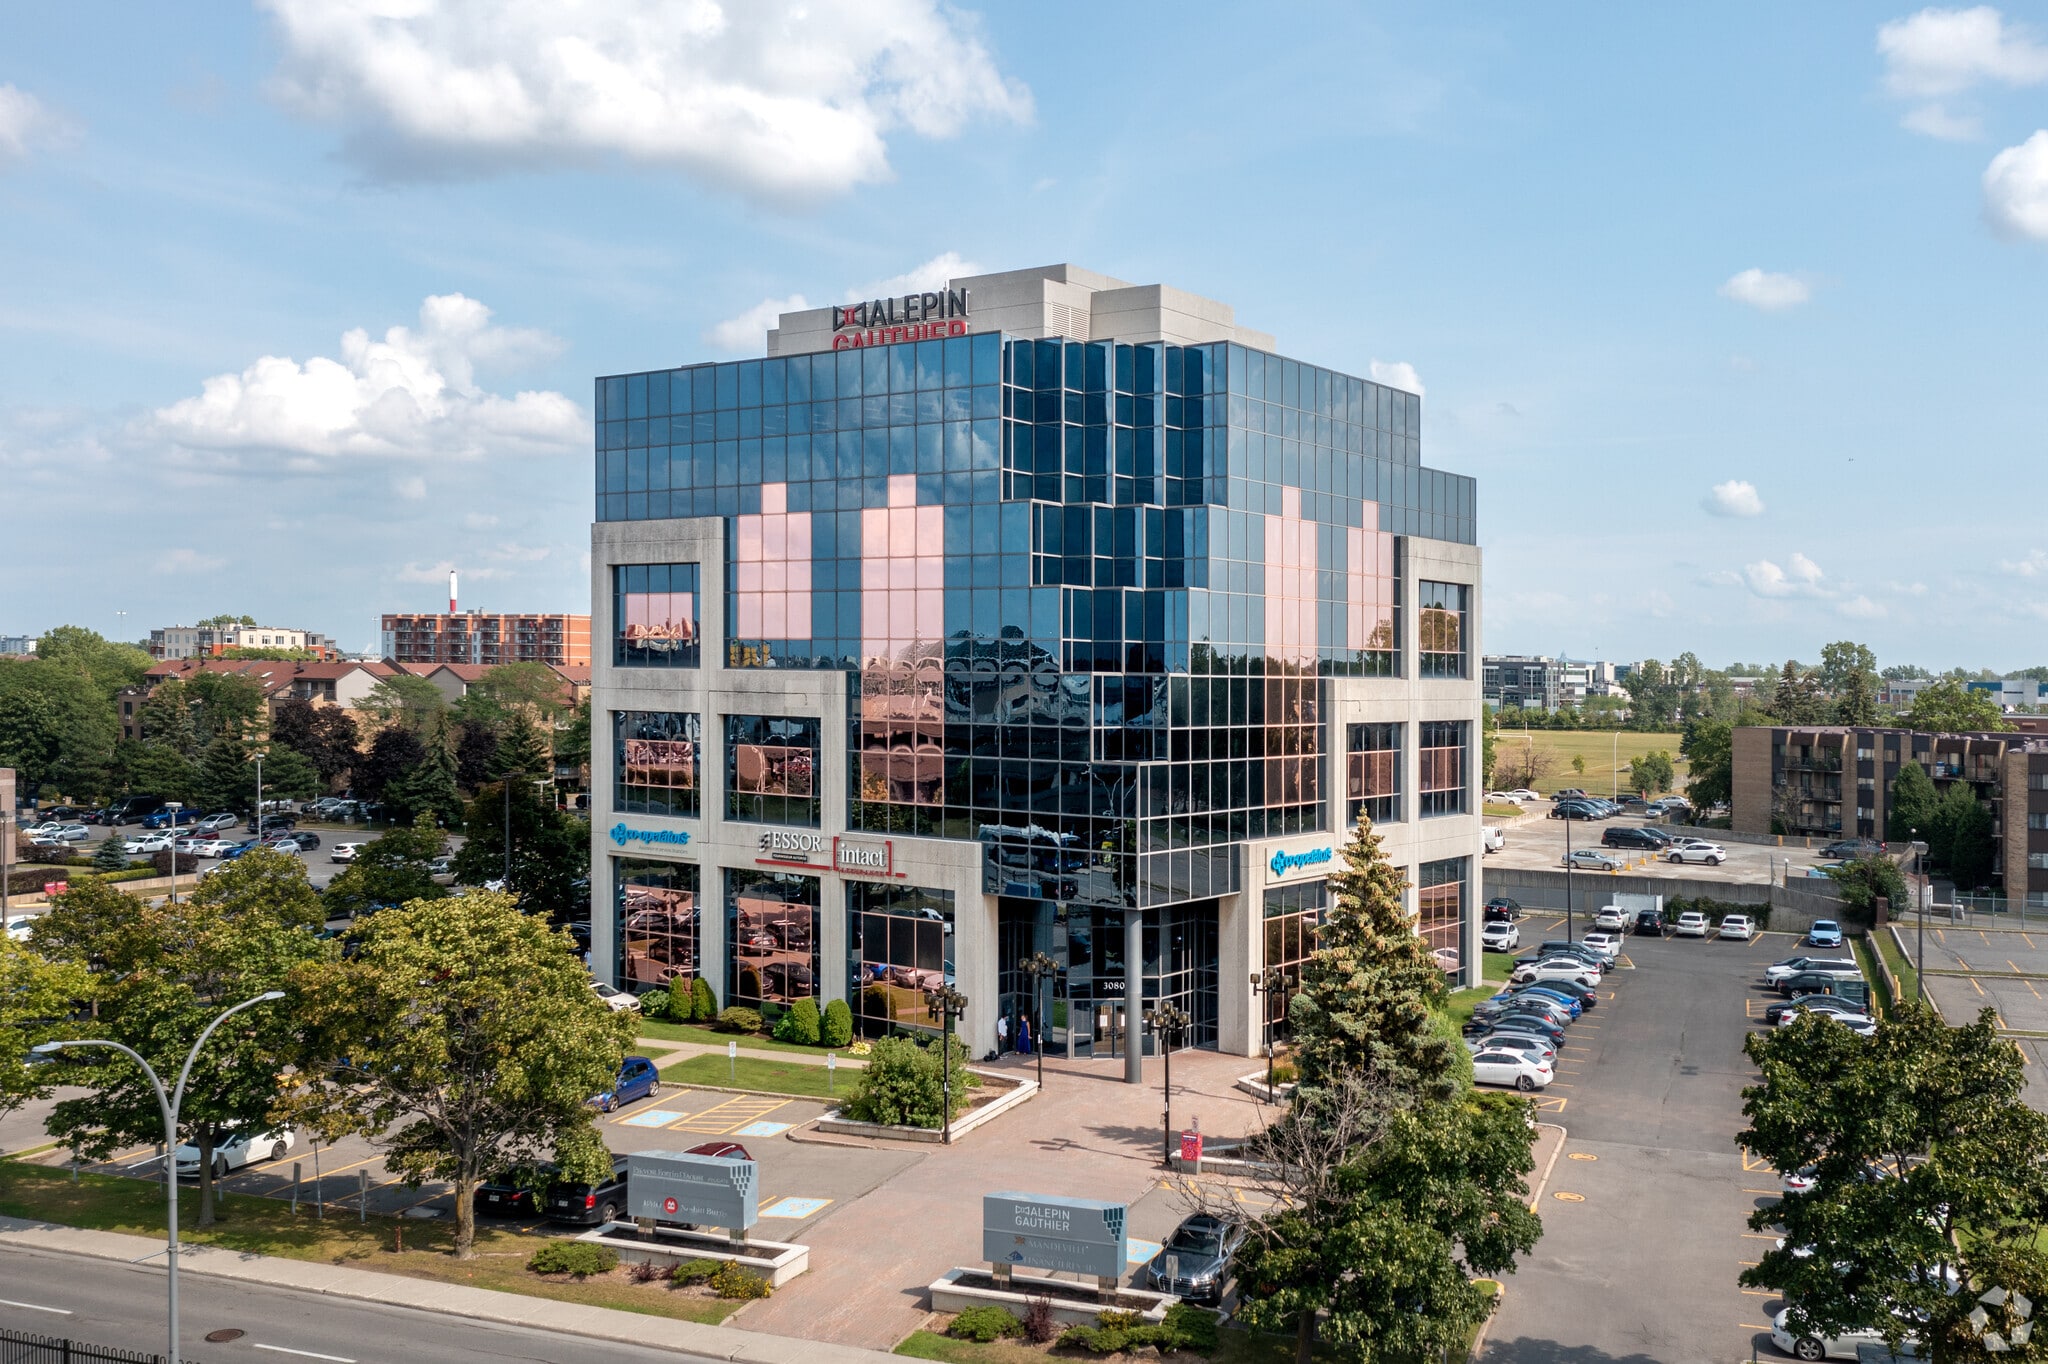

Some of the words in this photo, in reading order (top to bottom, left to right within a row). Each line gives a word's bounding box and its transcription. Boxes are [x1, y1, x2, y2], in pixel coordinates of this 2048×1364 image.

[772, 831, 822, 852] ESSOR
[840, 842, 886, 867] intact
[1103, 981, 1126, 990] 3080
[1015, 1216, 1070, 1231] GAUTHIER
